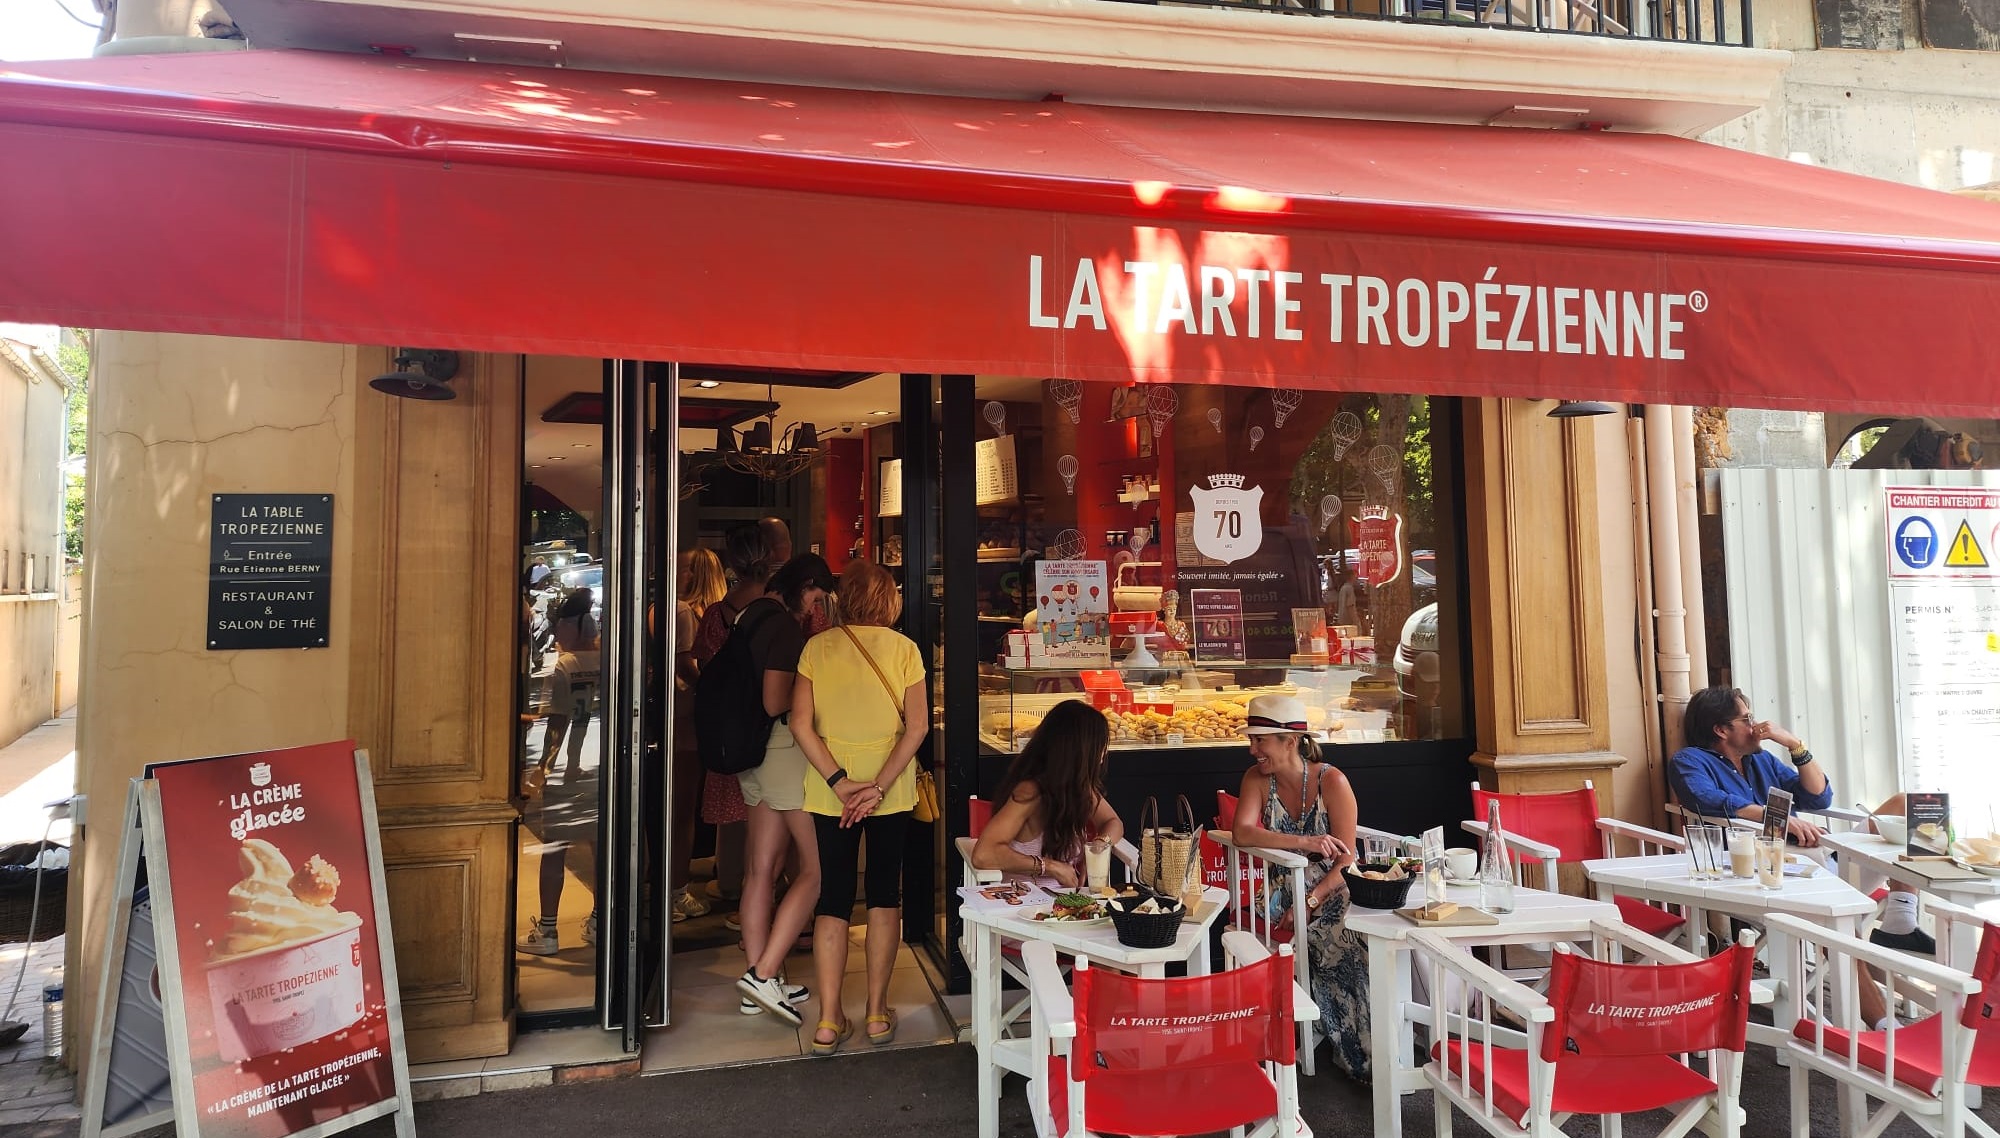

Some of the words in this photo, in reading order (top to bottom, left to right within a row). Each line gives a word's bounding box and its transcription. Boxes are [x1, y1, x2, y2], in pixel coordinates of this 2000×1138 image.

[1029, 254, 1107, 331] LA
[1124, 261, 1303, 342] TARTE
[1893, 495, 1940, 506] CHANTIER
[1942, 496, 1982, 507] INTERDIT
[1984, 497, 1996, 507] AU
[241, 506, 258, 518] LA
[263, 506, 304, 518] TABLE
[220, 523, 324, 535] TROPEZIENNE
[1213, 510, 1241, 539] 70
[1369, 539, 1387, 550] TARTE
[248, 550, 293, 560] Entrée
[220, 565, 240, 573] Rue
[243, 565, 284, 573] Etienne
[288, 565, 321, 573] BERNY
[1178, 571, 1206, 580] Souvent
[1208, 571, 1232, 580] imitée,
[1232, 571, 1256, 581] jamais
[1257, 570, 1278, 581] égalée
[222, 591, 315, 602] RESTAURANT
[264, 606, 273, 615] &
[1905, 606, 1941, 614] PERMIS
[218, 620, 263, 630] SALON
[269, 619, 286, 629] DE
[292, 617, 317, 629] THÉ
[230, 792, 252, 810] LA
[253, 783, 303, 806] CRÈME
[230, 804, 306, 841] glacée
[1214, 856, 1224, 868] LA
[232, 991, 243, 1005] LA
[244, 983, 276, 1002] TARTE
[1588, 1002, 1605, 1016] LA
[1608, 1006, 1646, 1019] TARTE
[1110, 1016, 1127, 1026] LA
[1130, 1017, 1169, 1026] TARTE
[215, 1100, 229, 1114] LA
[230, 1086, 263, 1108] CRÈME
[264, 1083, 277, 1096] DE
[278, 1078, 291, 1092] LA
[292, 1068, 320, 1087] TARTE
[320, 1047, 382, 1076] TROPÉZIENNE,
[248, 1088, 308, 1118] MAINTENANT
[310, 1074, 344, 1096] GLACÉE
